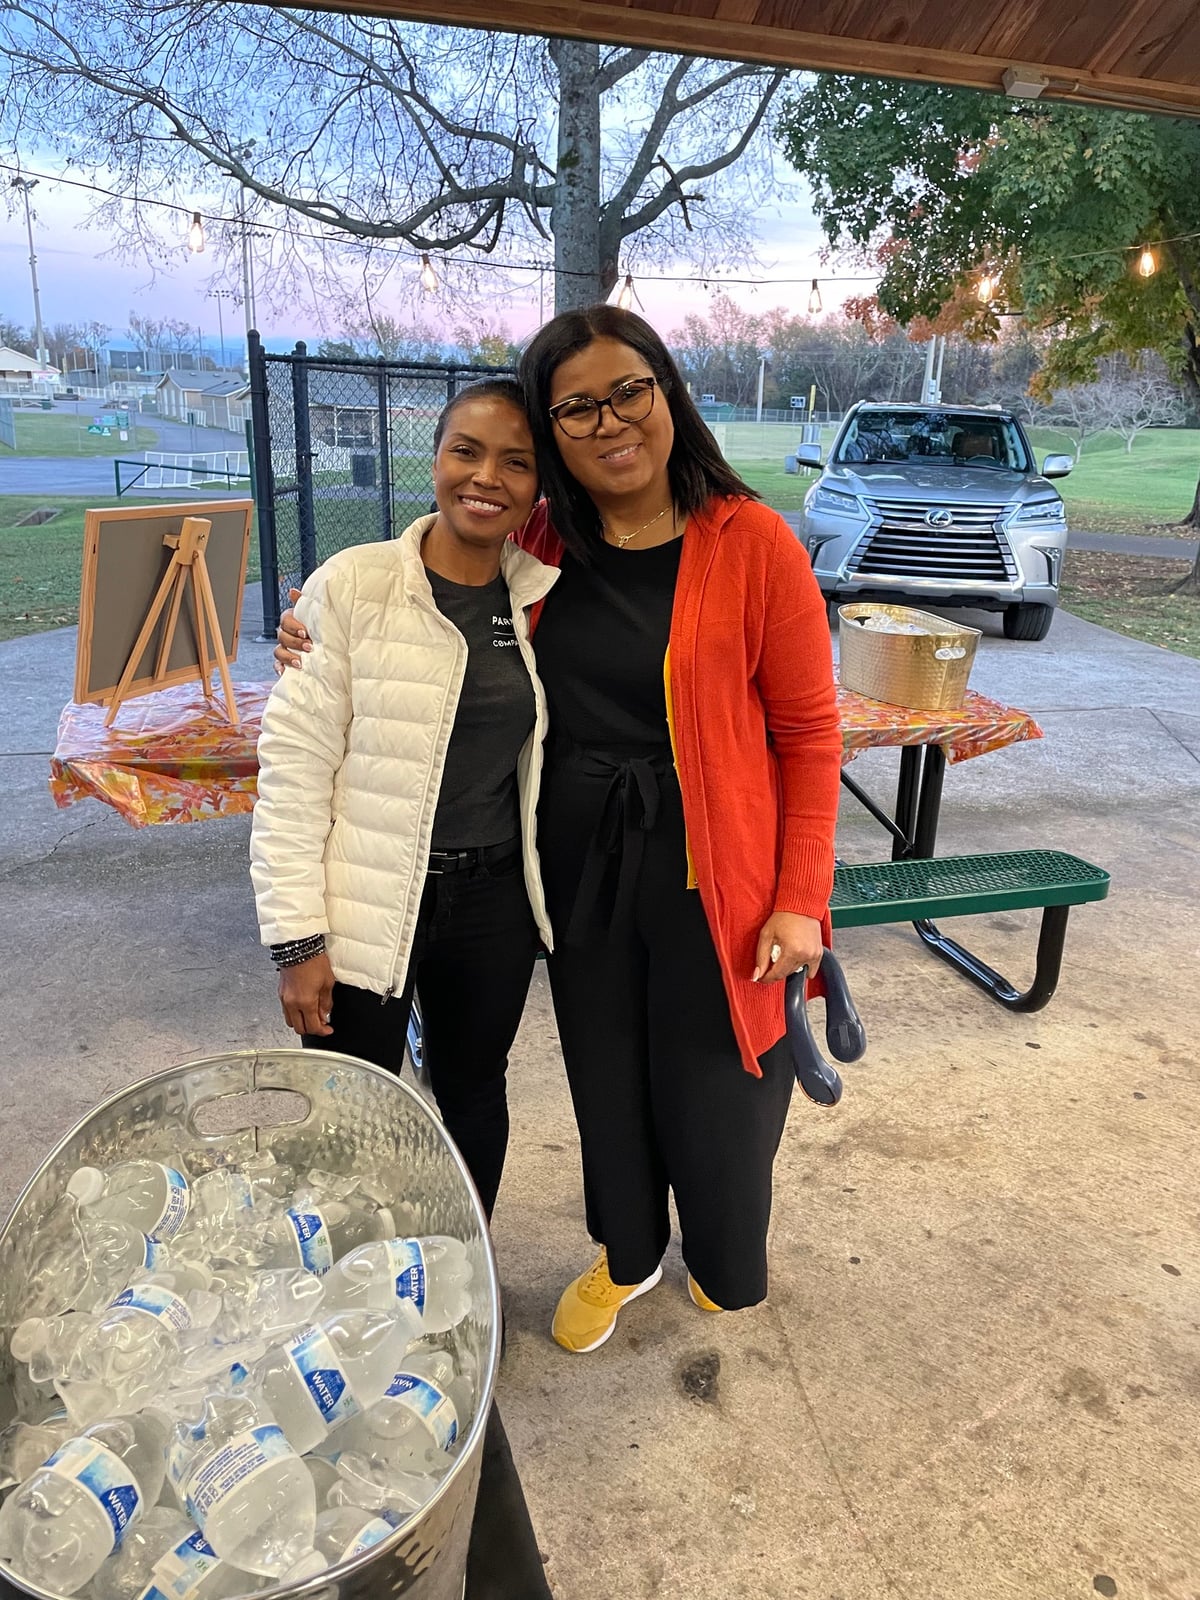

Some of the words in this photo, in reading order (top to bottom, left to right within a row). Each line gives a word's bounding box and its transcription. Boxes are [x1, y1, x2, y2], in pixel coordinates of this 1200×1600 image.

[409, 1266, 420, 1303] WATER
[312, 1370, 335, 1408] WATER
[392, 1377, 414, 1389] WAT
[107, 1489, 128, 1529] WATER
